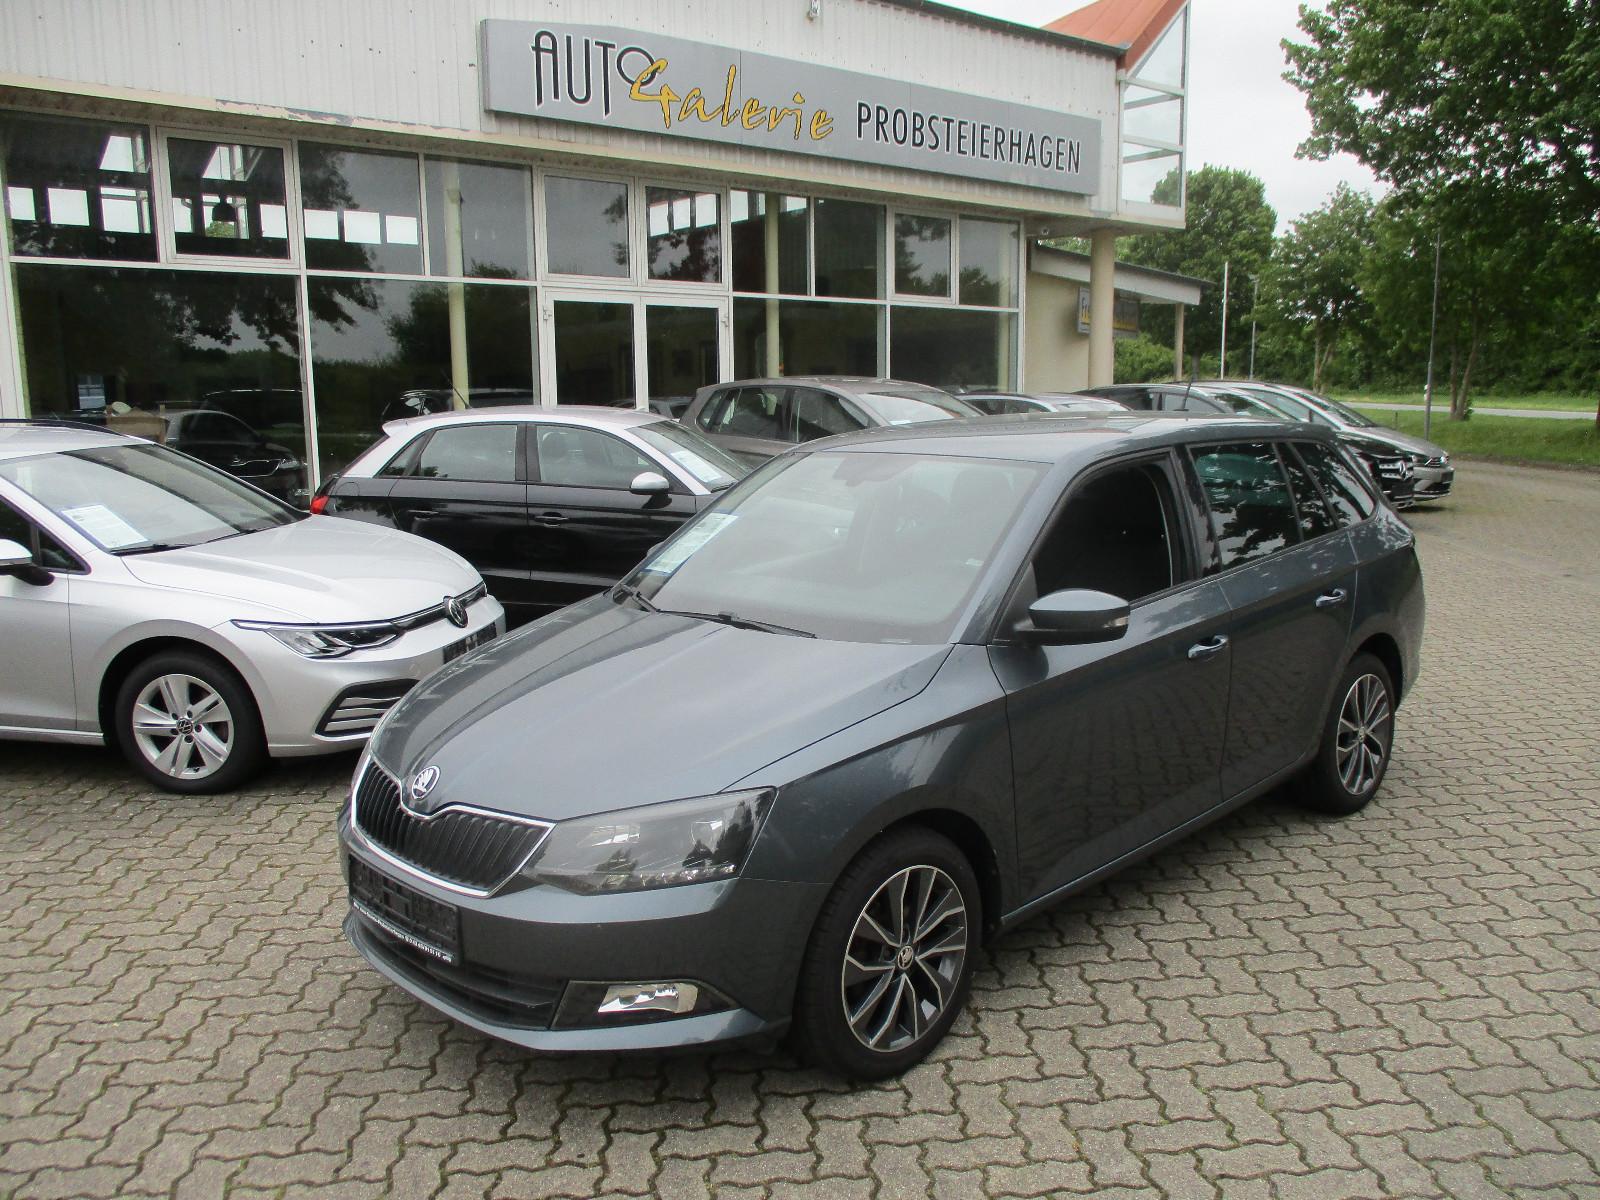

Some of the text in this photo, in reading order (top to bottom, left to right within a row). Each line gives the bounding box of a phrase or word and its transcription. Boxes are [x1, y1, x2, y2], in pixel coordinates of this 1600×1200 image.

[530, 29, 1081, 174] AUTO Galerie PROBSTEIERHAGEN
